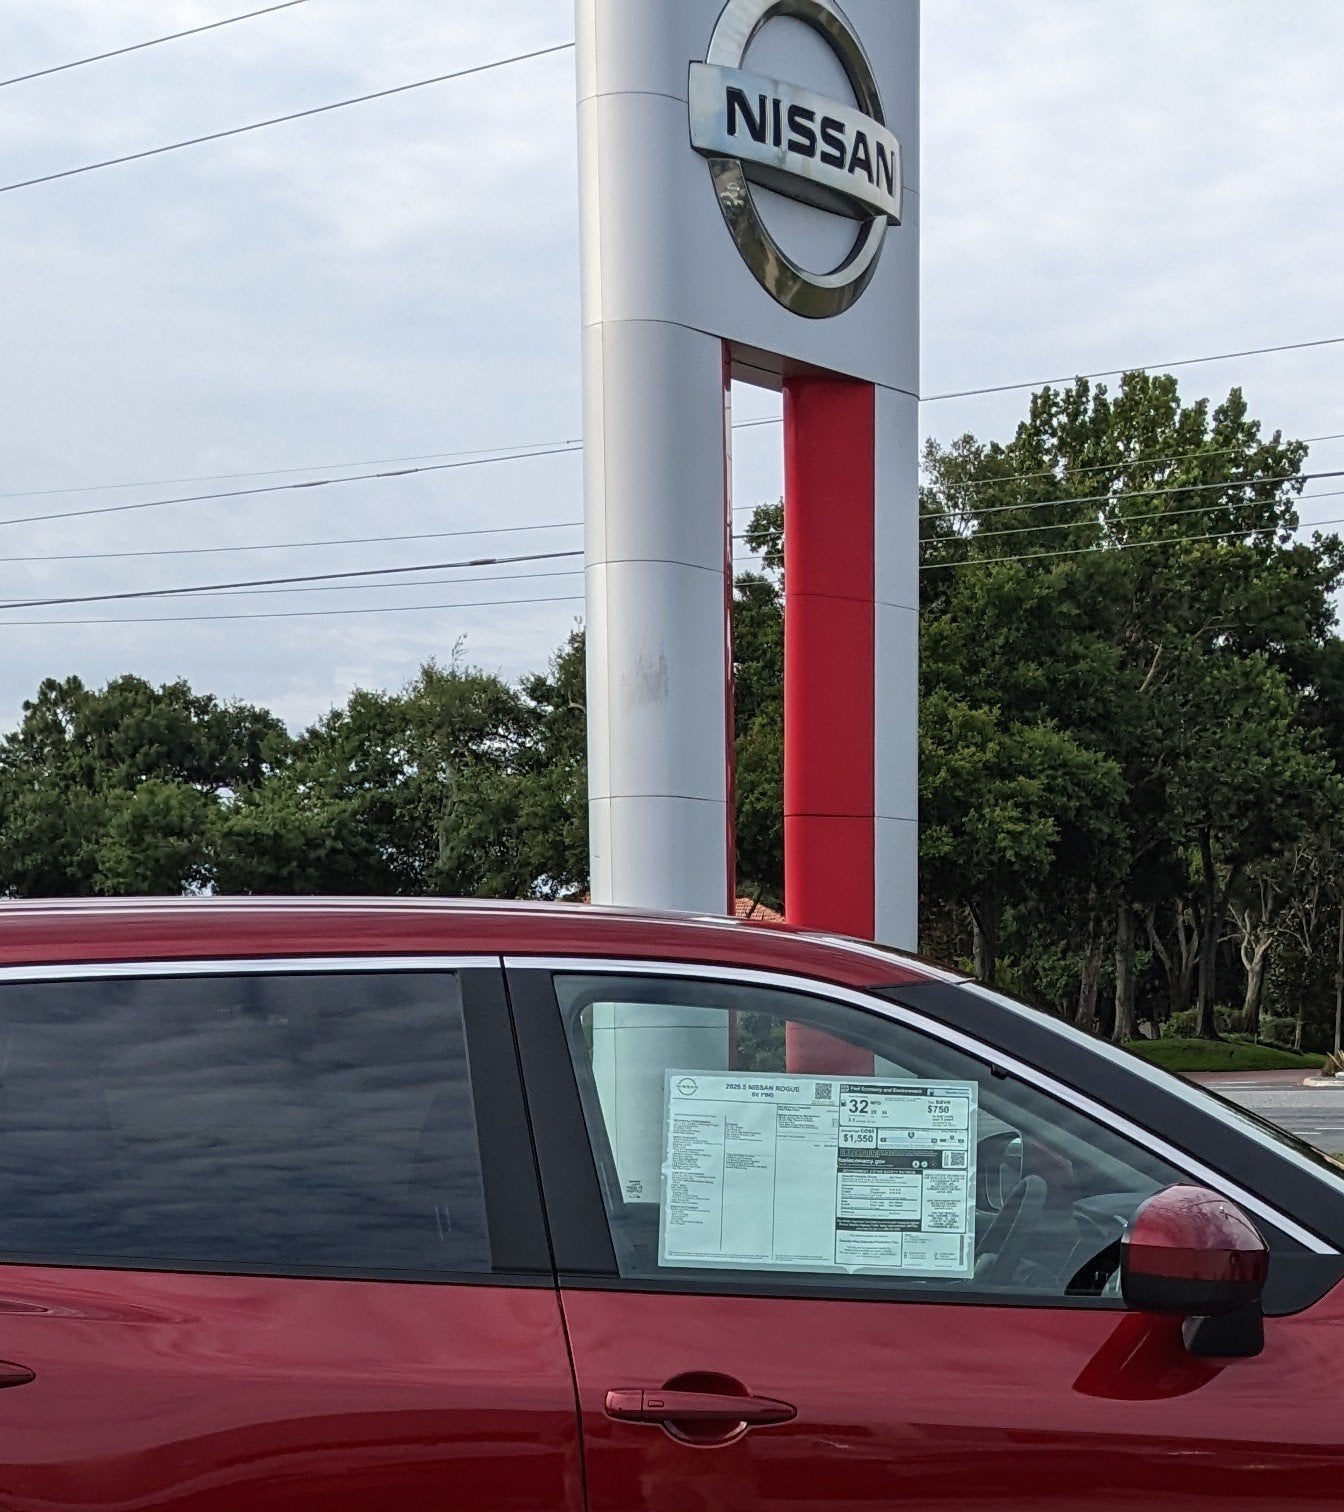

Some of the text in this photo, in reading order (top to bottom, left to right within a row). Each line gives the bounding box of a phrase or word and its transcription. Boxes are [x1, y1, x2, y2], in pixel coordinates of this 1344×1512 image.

[725, 86, 895, 198] NISSAN
[849, 1099, 868, 1114] 32
[927, 1105, 949, 1114] $750
[843, 1134, 874, 1143] $1,550
